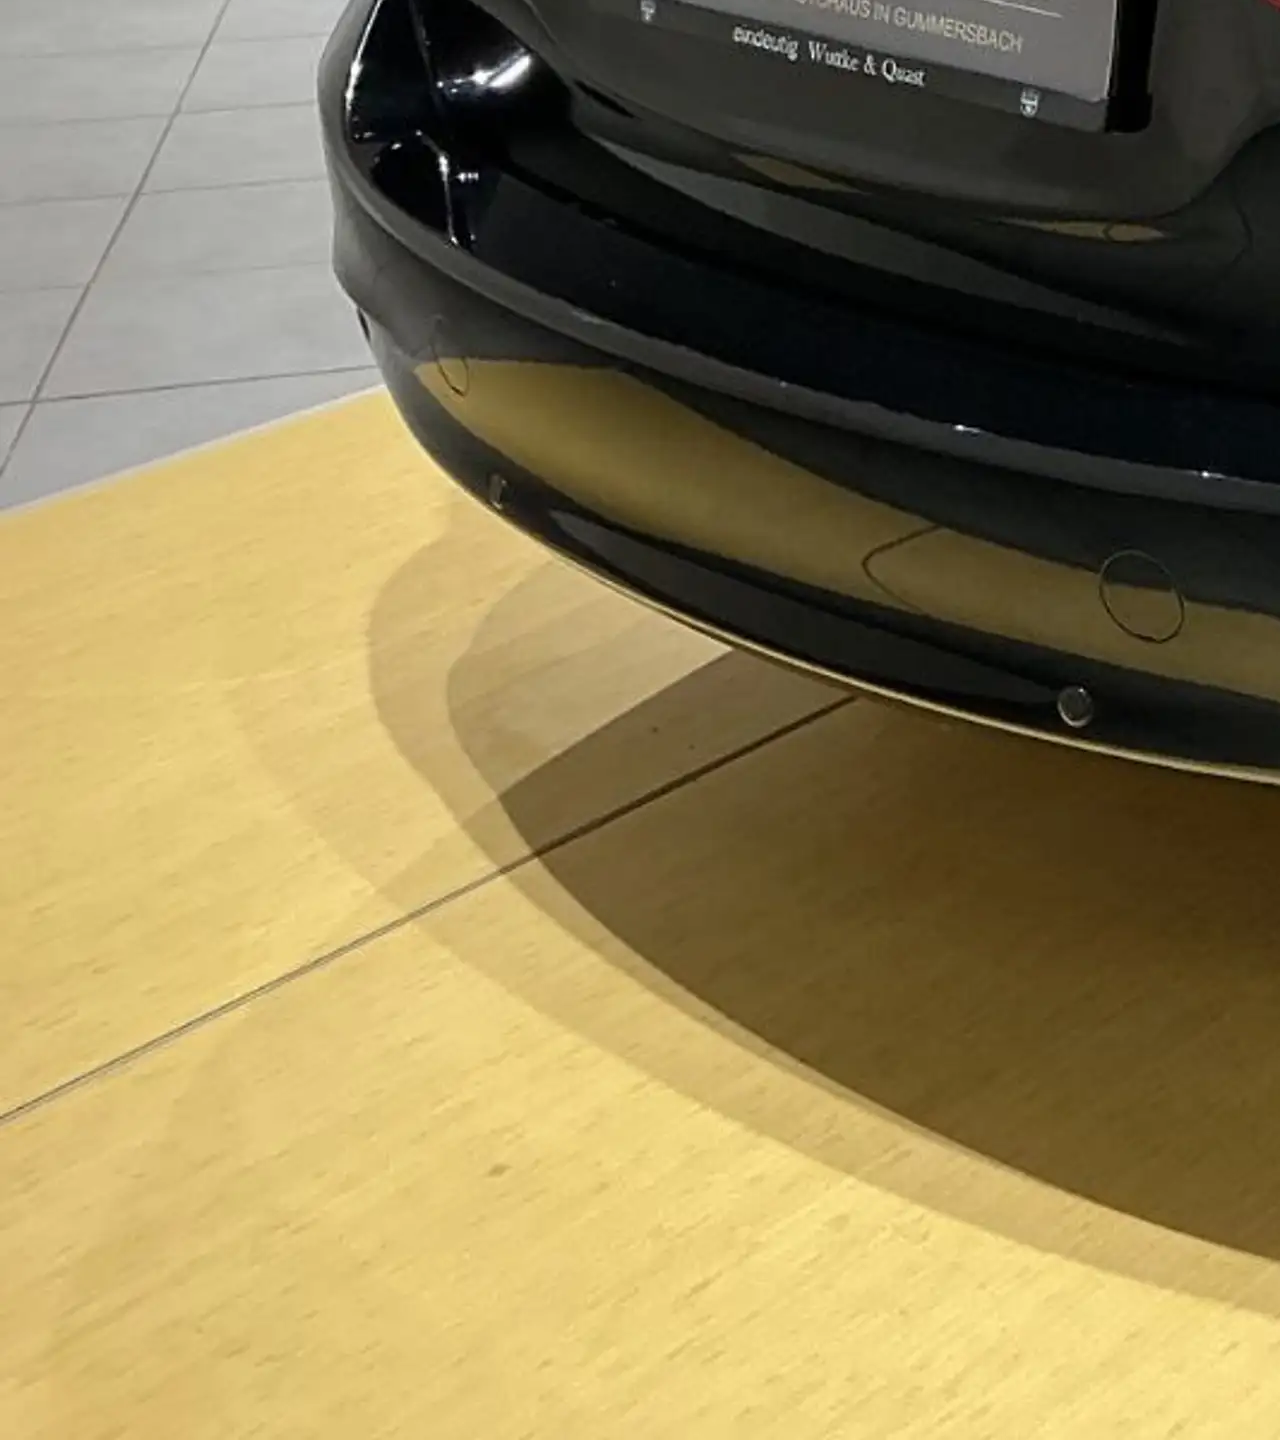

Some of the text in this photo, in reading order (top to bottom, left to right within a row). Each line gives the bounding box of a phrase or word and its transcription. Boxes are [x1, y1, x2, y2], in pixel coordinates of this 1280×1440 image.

[873, 1, 891, 25] IN
[893, 5, 1023, 54] GUMMERSBACH
[863, 53, 878, 76] &
[881, 58, 926, 87] Quast
